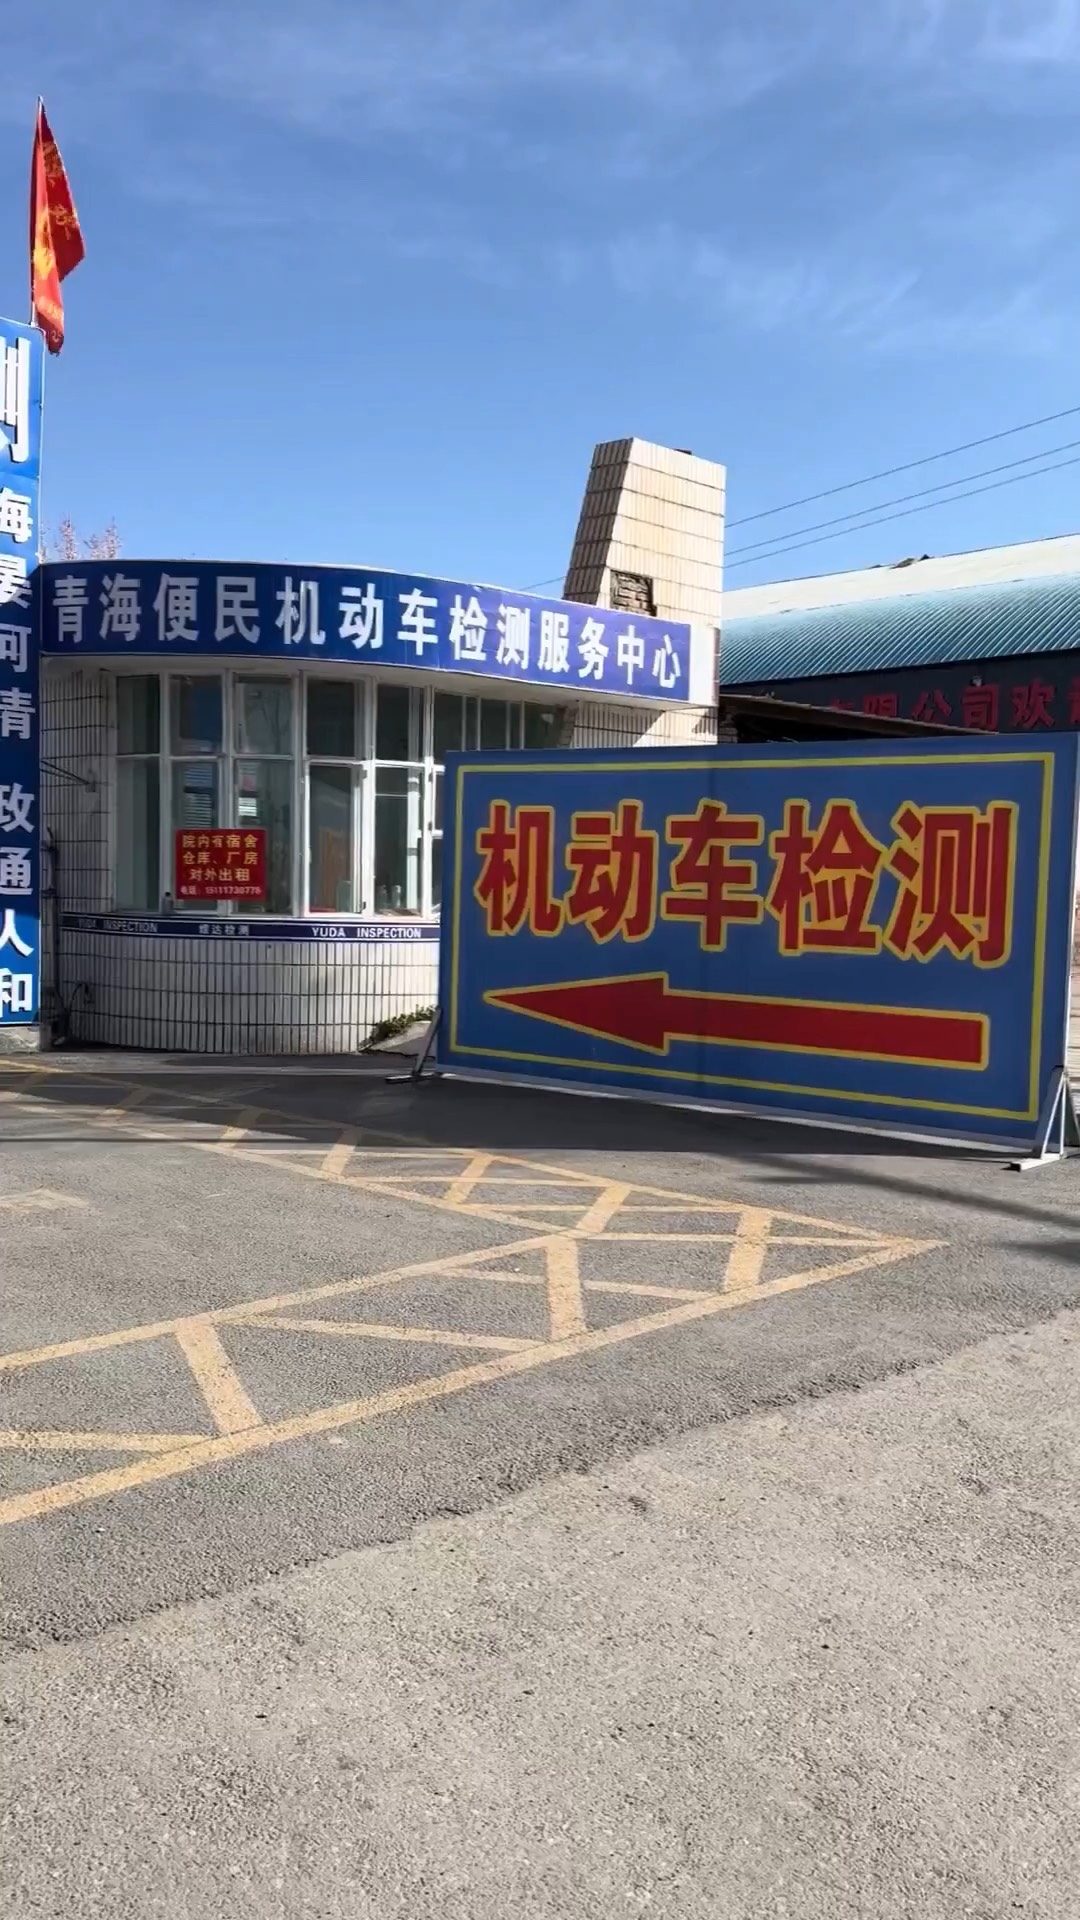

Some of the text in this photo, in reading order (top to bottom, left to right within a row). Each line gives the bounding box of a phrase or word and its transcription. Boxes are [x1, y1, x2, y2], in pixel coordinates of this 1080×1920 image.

[52, 572, 681, 689] 青海便民机动车检测服务中心
[182, 834, 258, 848] 院内有宿舍
[189, 868, 250, 882] 对外出租
[475, 798, 1019, 968] 机动车检测
[103, 919, 158, 932] INSPECTION
[312, 927, 422, 938] YUDA INSPECTION
